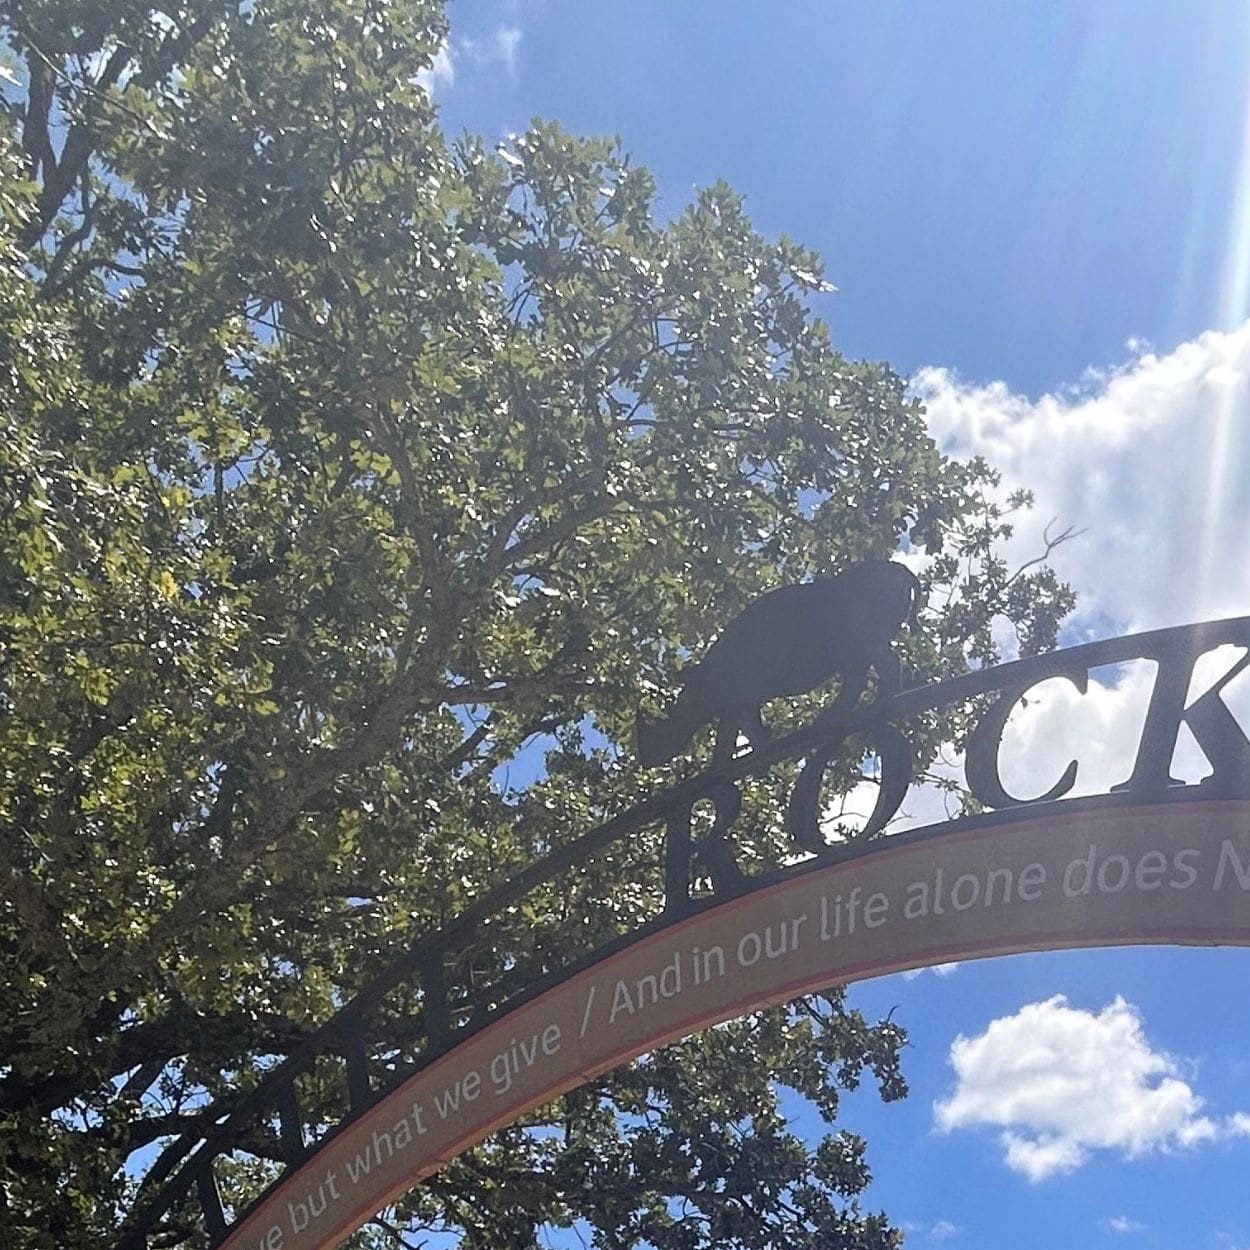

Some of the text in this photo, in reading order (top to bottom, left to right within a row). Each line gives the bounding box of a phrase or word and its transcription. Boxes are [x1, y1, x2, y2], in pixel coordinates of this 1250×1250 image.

[289, 1170, 342, 1230] but
[344, 1104, 428, 1186] what
[433, 1067, 482, 1120] we
[490, 1023, 562, 1095] give
[608, 956, 682, 1024] And
[692, 942, 725, 986] in
[737, 912, 808, 966] our
[819, 887, 890, 941] life
[903, 861, 1047, 921] alone
[1062, 843, 1200, 898] does
